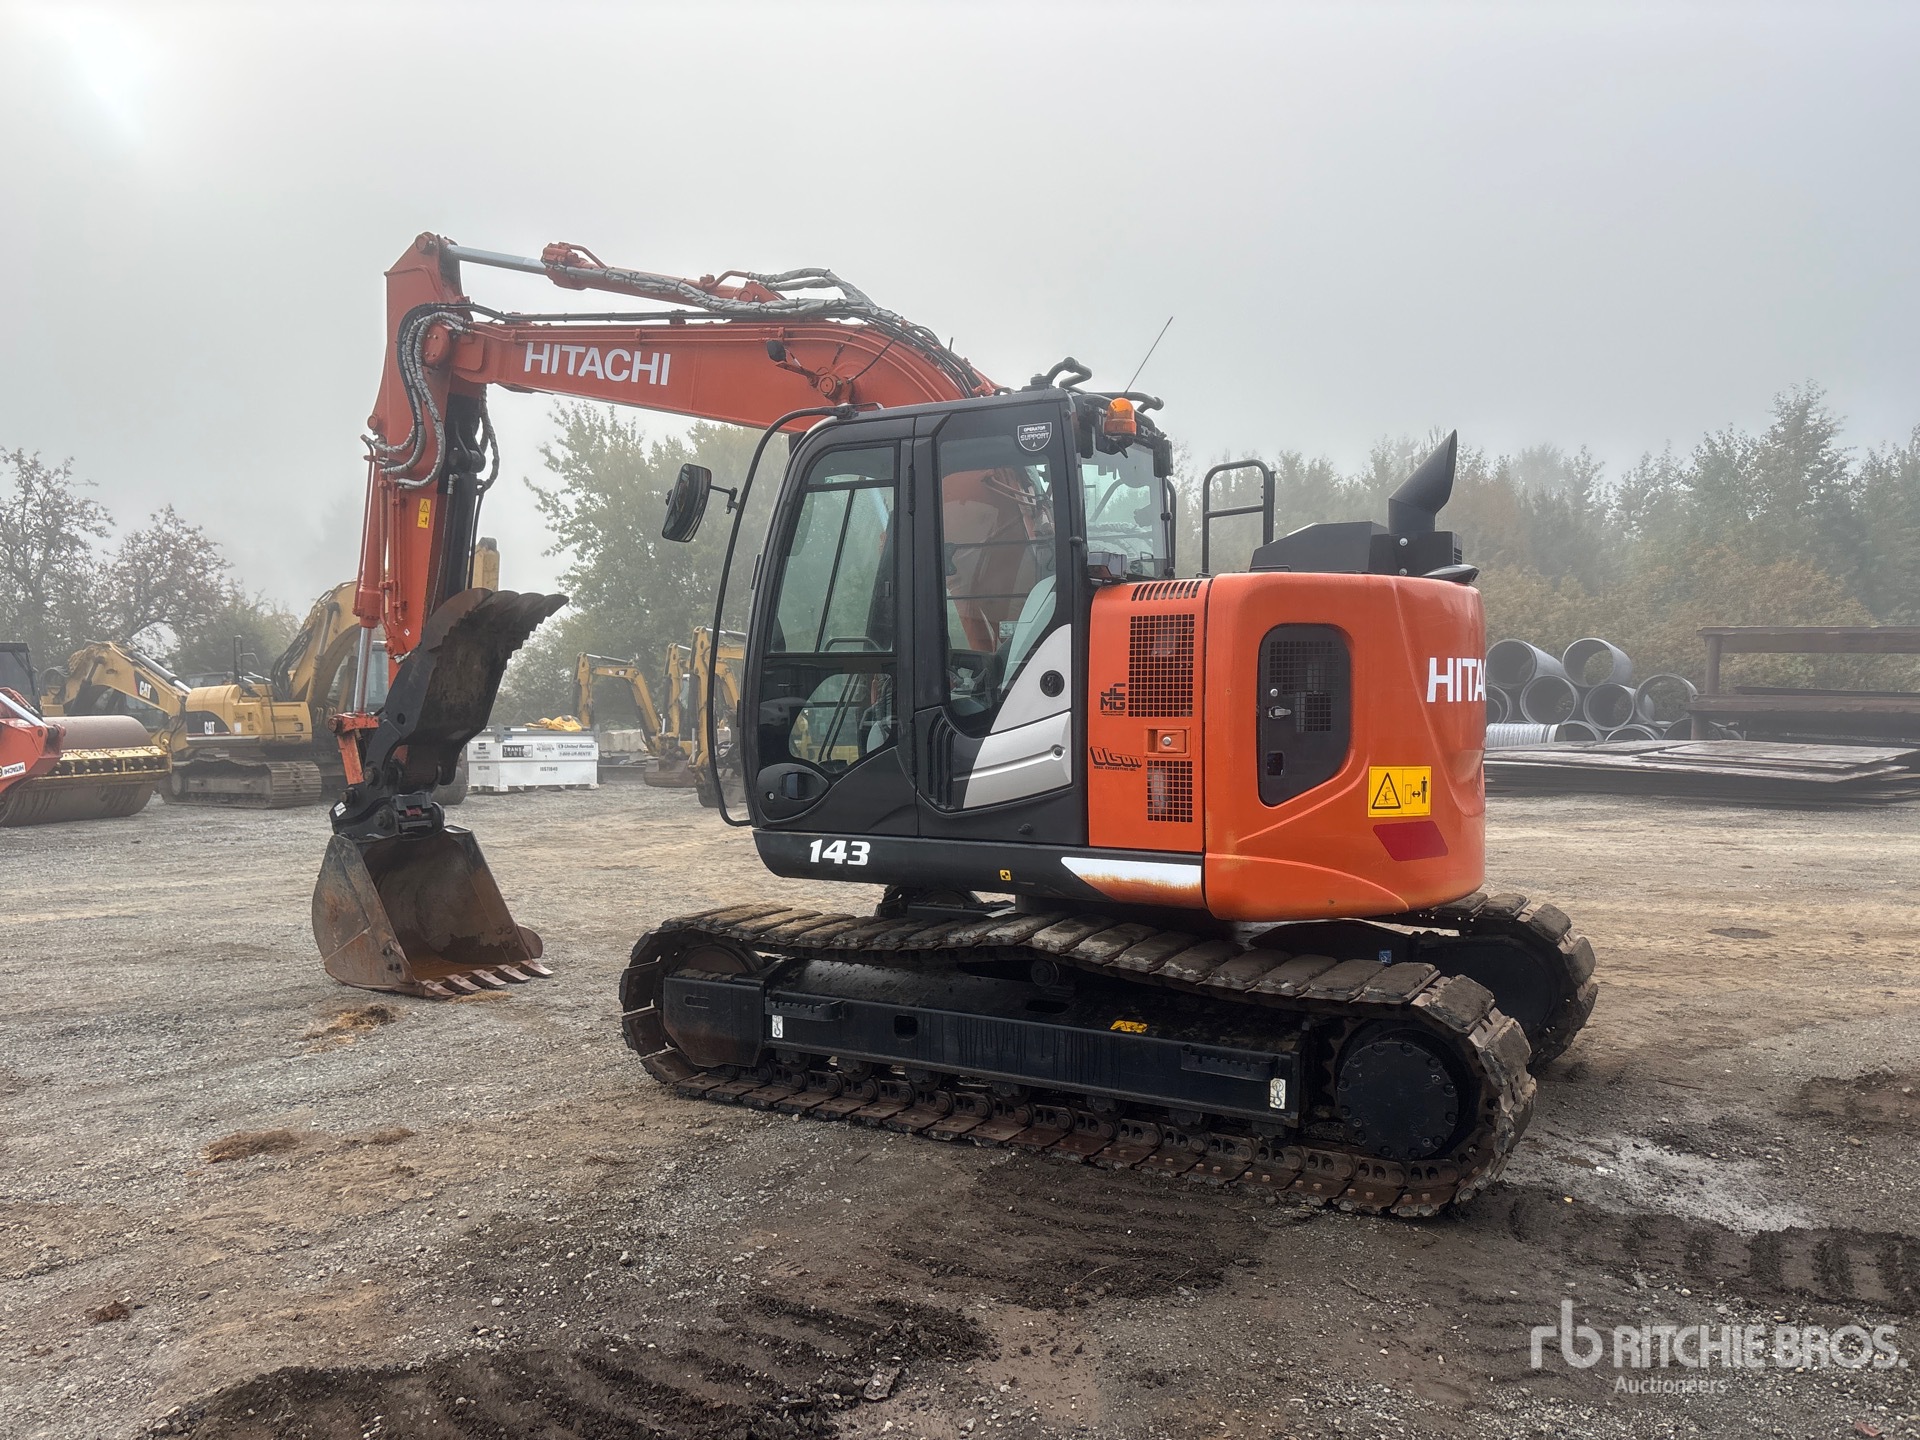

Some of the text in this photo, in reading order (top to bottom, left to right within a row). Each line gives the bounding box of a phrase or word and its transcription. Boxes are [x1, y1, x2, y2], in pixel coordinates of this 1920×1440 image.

[524, 342, 671, 386] HITACHI
[1020, 432, 1050, 441] SUPPORT
[139, 681, 152, 699] CAT
[1426, 657, 1487, 702] HITA
[204, 721, 215, 735] CAT
[810, 839, 871, 866] 143
